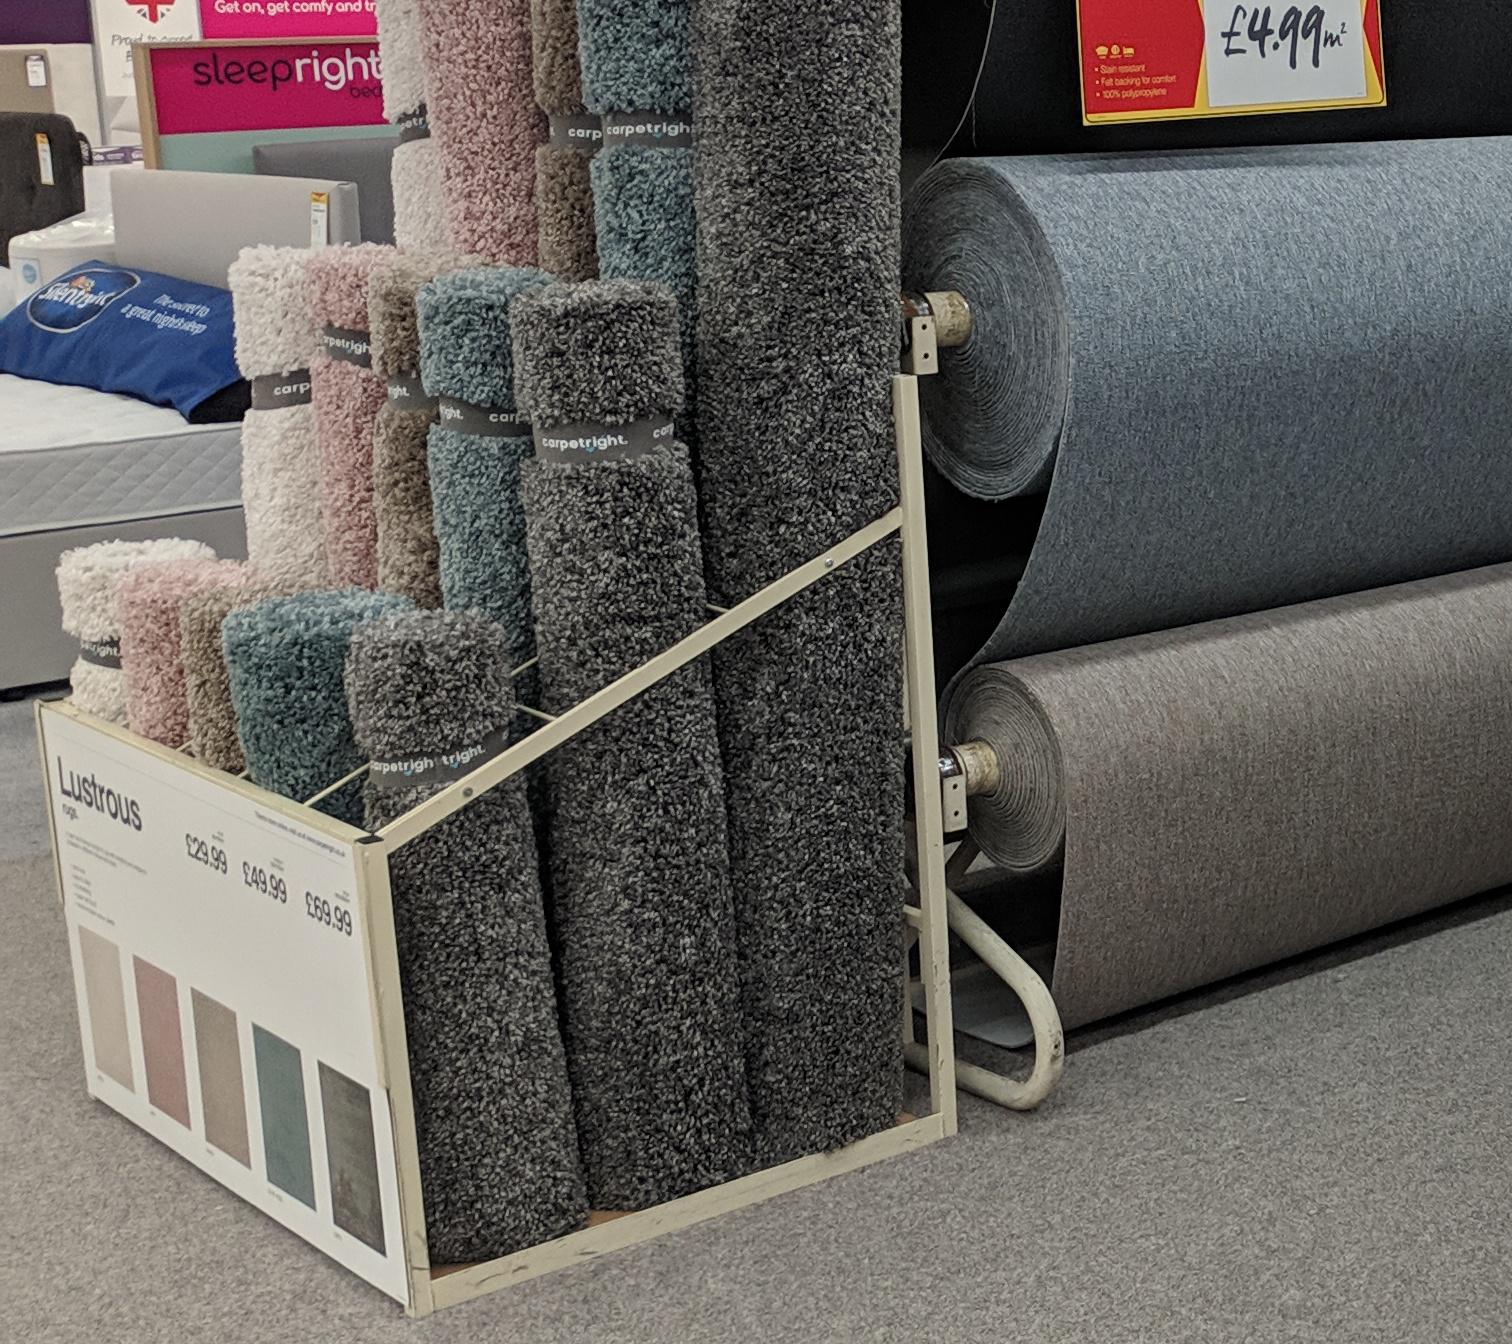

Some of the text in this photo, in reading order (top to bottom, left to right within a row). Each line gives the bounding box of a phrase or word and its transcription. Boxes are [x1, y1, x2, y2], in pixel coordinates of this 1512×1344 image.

[215, 0, 240, 13] Get
[267, 0, 290, 16] get
[293, 0, 333, 15] comfy
[335, 0, 362, 13] and
[1220, 5, 1325, 70] £4.99
[193, 47, 384, 91] sleepright
[57, 755, 142, 831] Lustrous
[186, 833, 228, 874] £29.99
[243, 861, 287, 904] £49.99
[305, 891, 352, 936] £69.99
